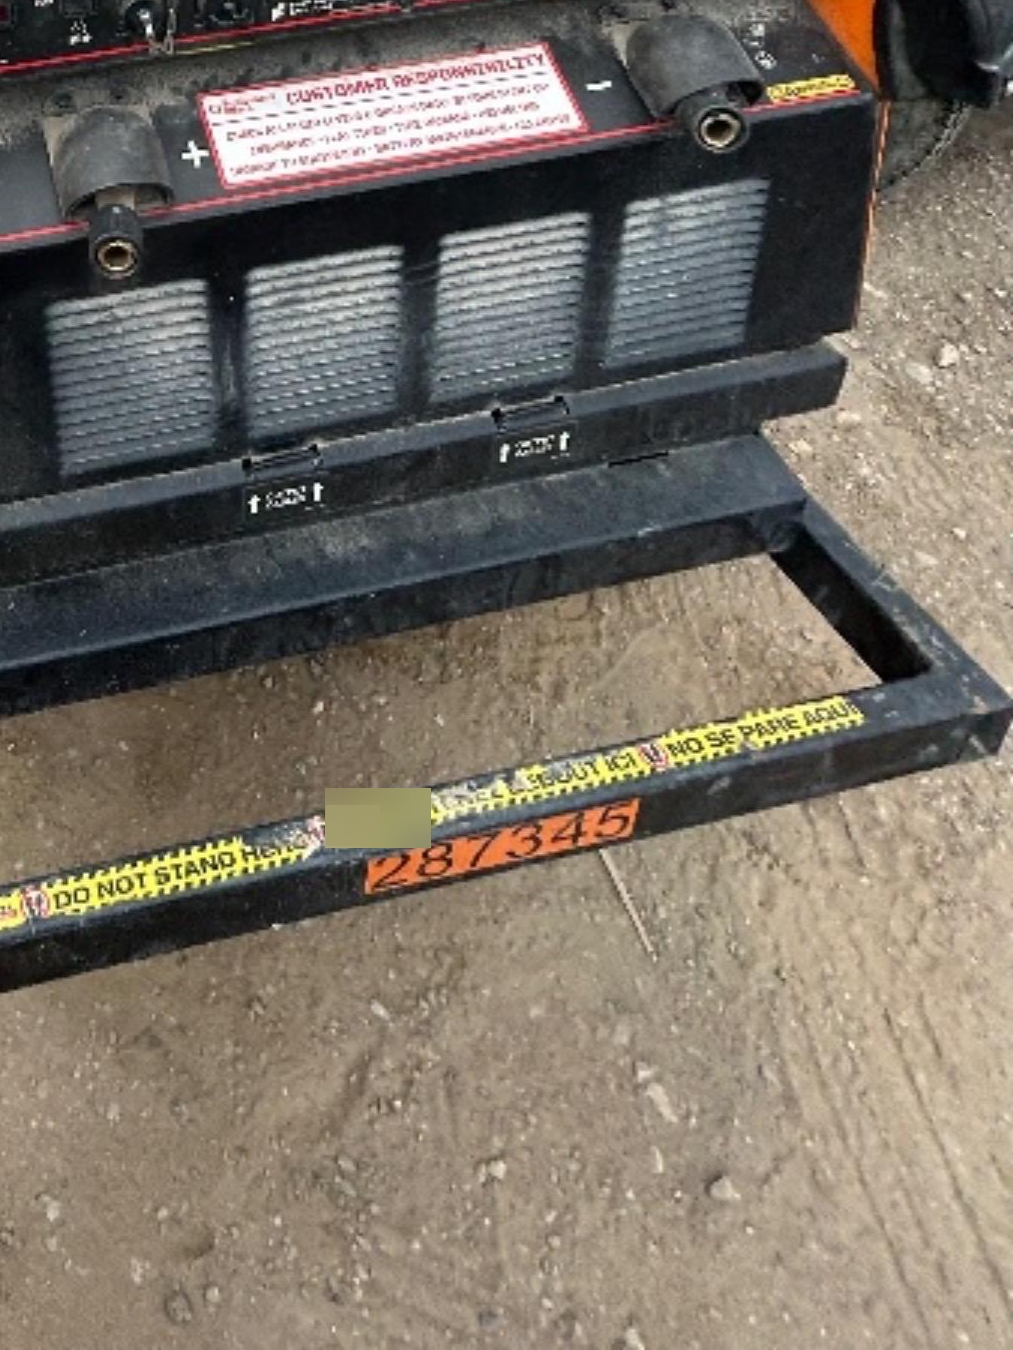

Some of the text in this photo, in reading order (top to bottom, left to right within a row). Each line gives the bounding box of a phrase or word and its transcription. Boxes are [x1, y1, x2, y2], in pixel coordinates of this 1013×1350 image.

[668, 737, 704, 758] NO
[704, 727, 736, 749] SE
[738, 713, 800, 740] PARE
[372, 805, 630, 891] 287345
[54, 887, 90, 911] DO
[97, 871, 149, 899] NOT
[154, 850, 237, 887] STAND
